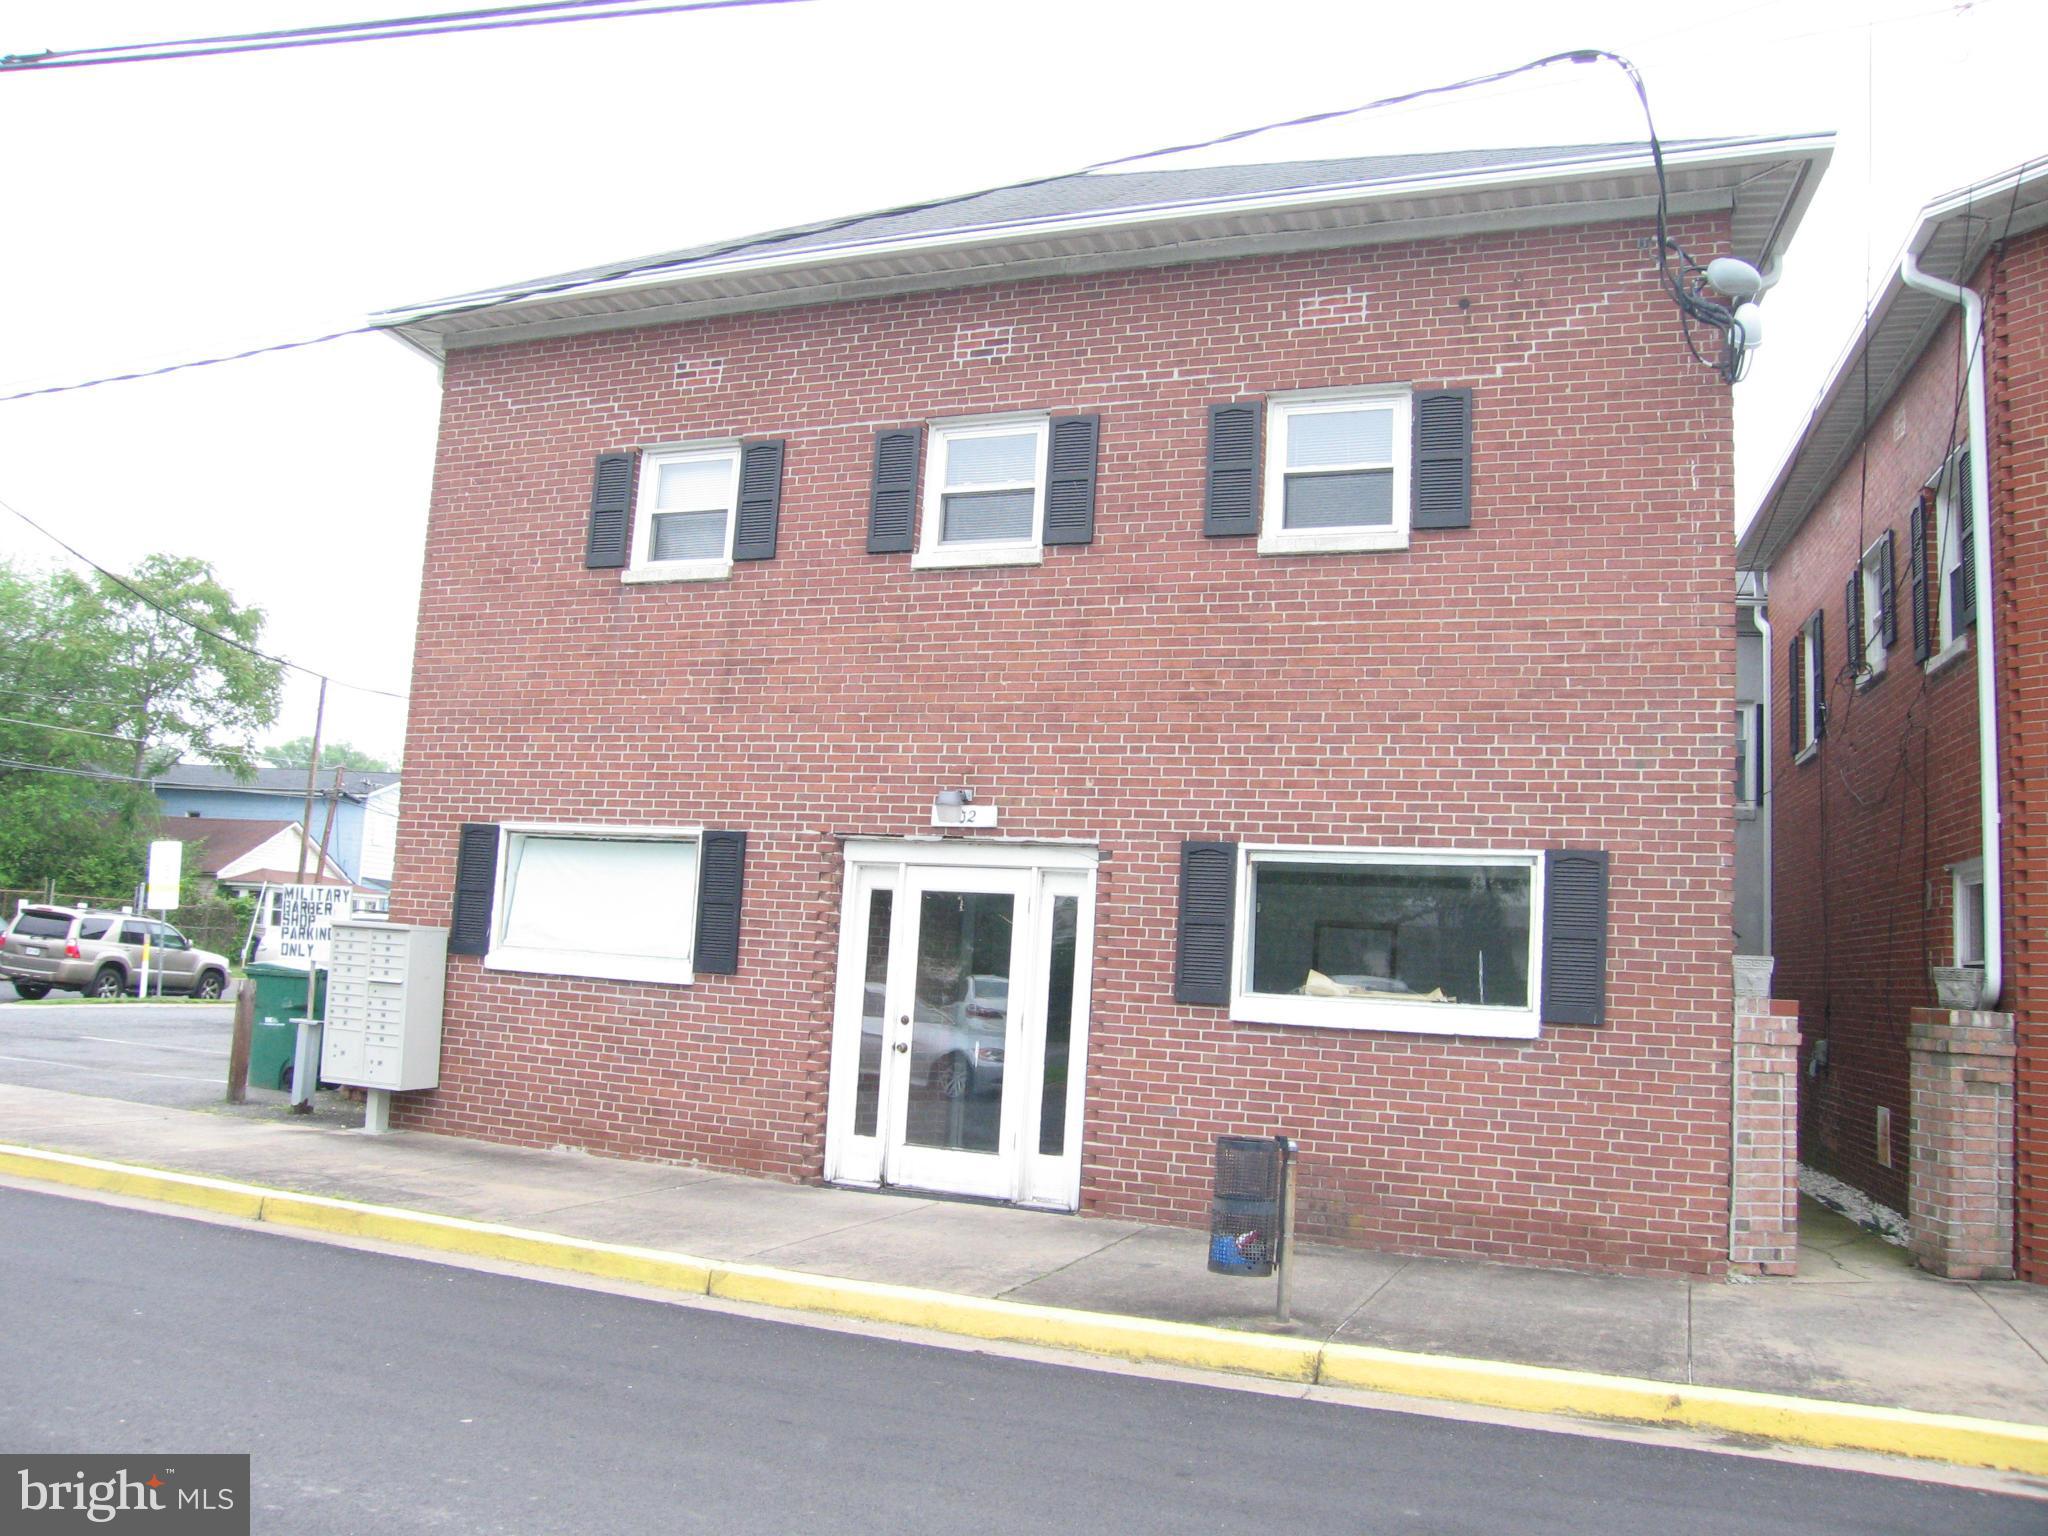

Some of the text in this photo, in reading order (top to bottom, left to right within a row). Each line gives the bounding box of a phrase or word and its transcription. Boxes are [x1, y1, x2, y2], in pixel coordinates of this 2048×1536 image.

[284, 887, 350, 903] MILITARY
[283, 900, 333, 916] BARBER
[282, 914, 316, 928] SHOP
[281, 943, 314, 957] ONLY
